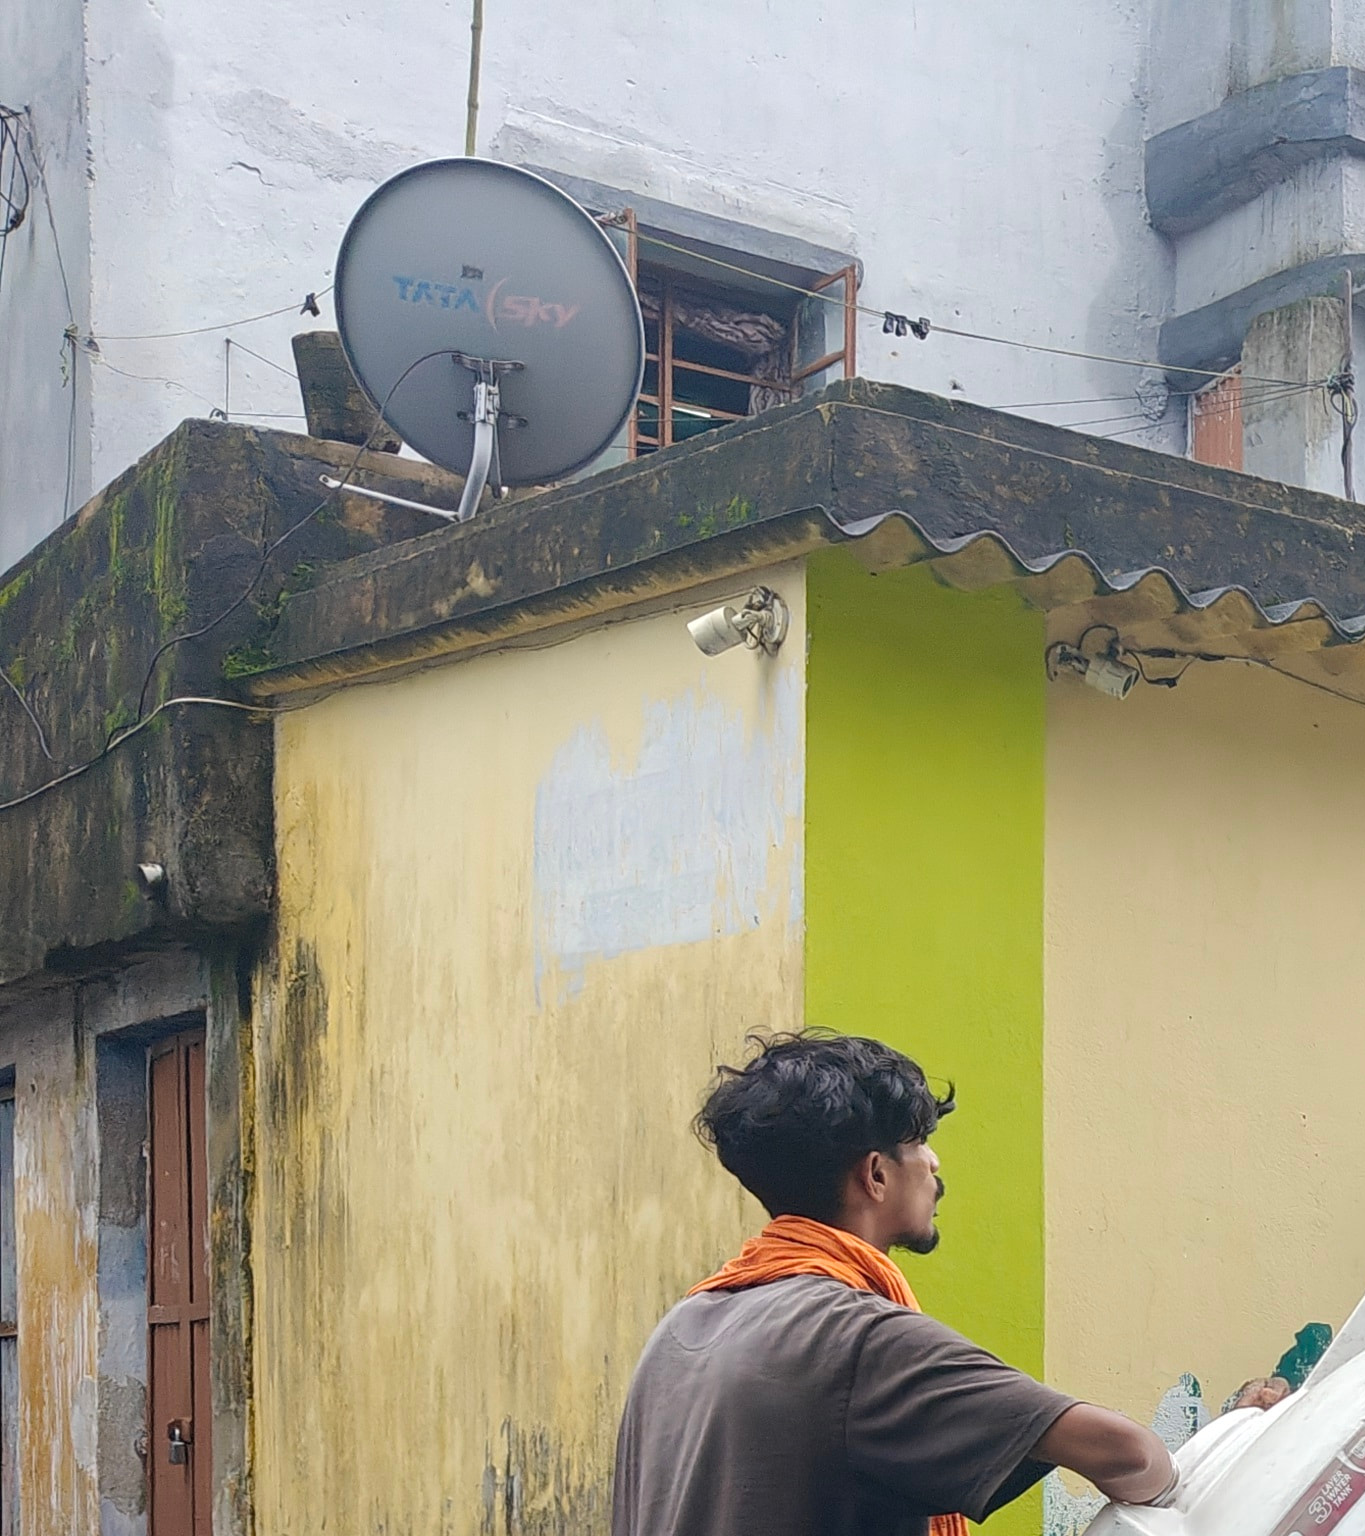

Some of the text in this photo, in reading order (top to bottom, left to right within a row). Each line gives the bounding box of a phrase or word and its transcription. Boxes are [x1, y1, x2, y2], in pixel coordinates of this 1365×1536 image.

[393, 275, 480, 314] TATA
[1319, 1467, 1345, 1496] LAYER
[1326, 1471, 1353, 1502] WATER
[1332, 1482, 1354, 1507] TANK
[1304, 1494, 1335, 1525] 3
